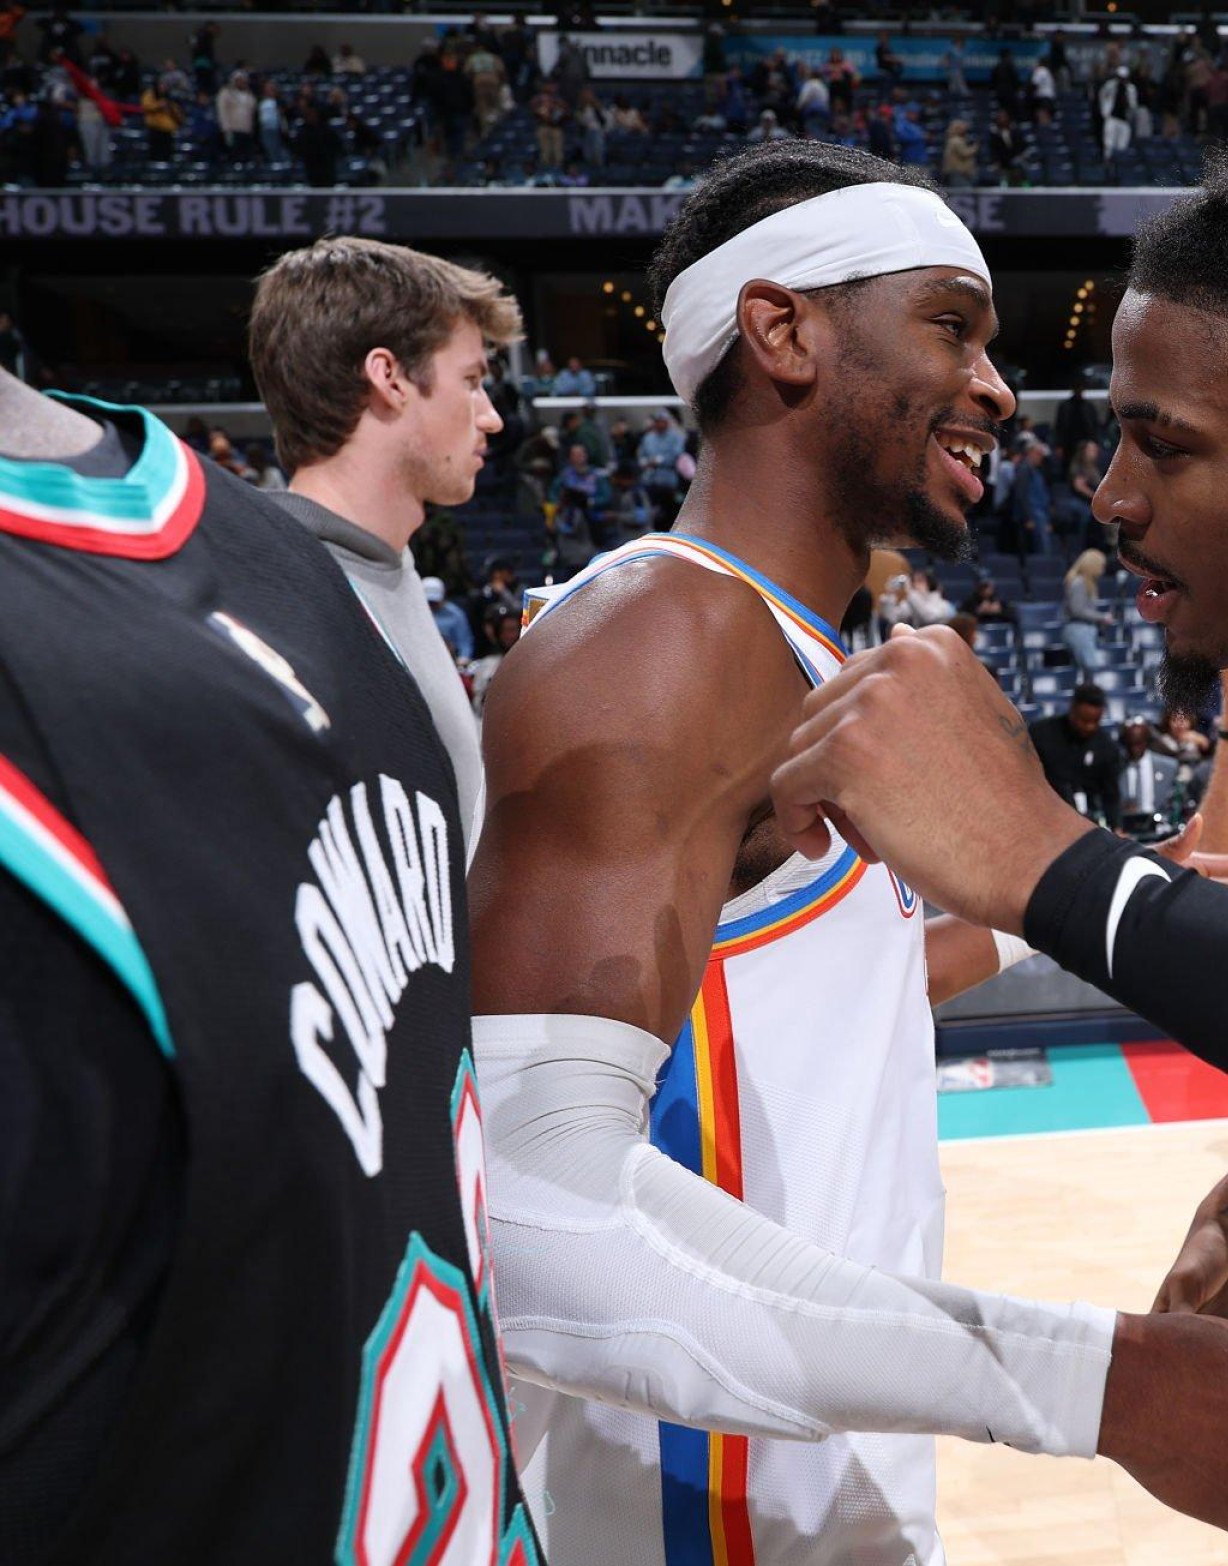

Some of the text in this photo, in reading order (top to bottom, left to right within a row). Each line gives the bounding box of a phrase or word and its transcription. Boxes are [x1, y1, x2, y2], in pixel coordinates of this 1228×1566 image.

[581, 39, 673, 67] nnacle
[178, 196, 311, 235] RULE
[326, 196, 387, 234] #2
[568, 195, 685, 233] MAK
[290, 772, 456, 1178] COWARD
